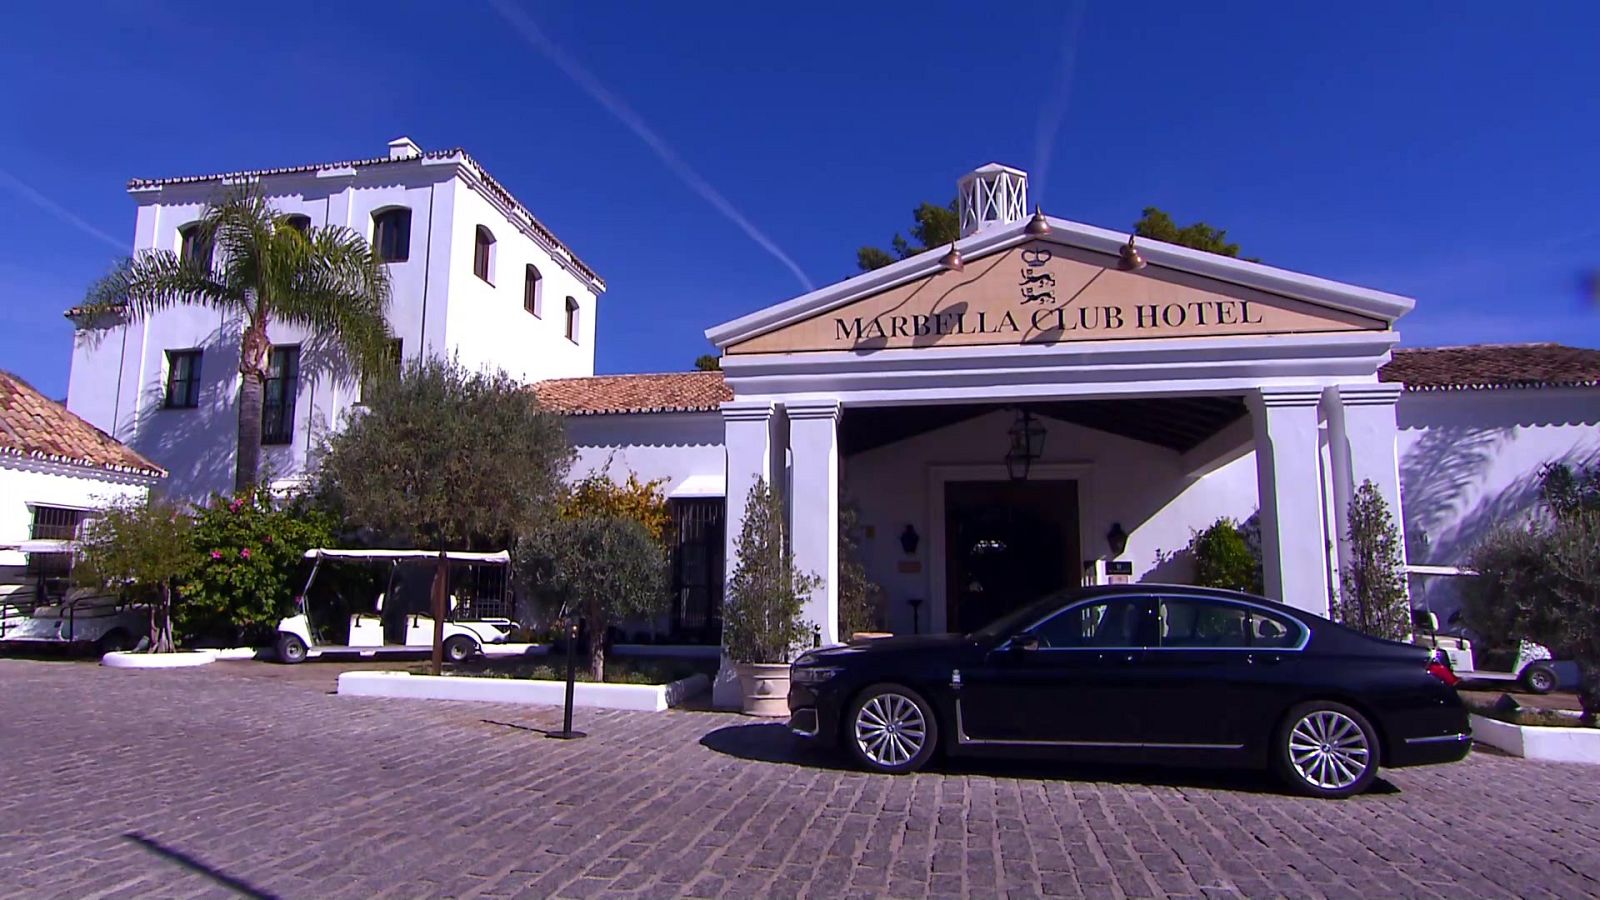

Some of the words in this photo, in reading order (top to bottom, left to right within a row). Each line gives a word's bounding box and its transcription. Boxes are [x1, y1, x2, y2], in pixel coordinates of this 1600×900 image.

[835, 310, 1020, 340] MARBELLA
[1031, 305, 1124, 332] CLUB
[1134, 301, 1263, 329] HOTEL
